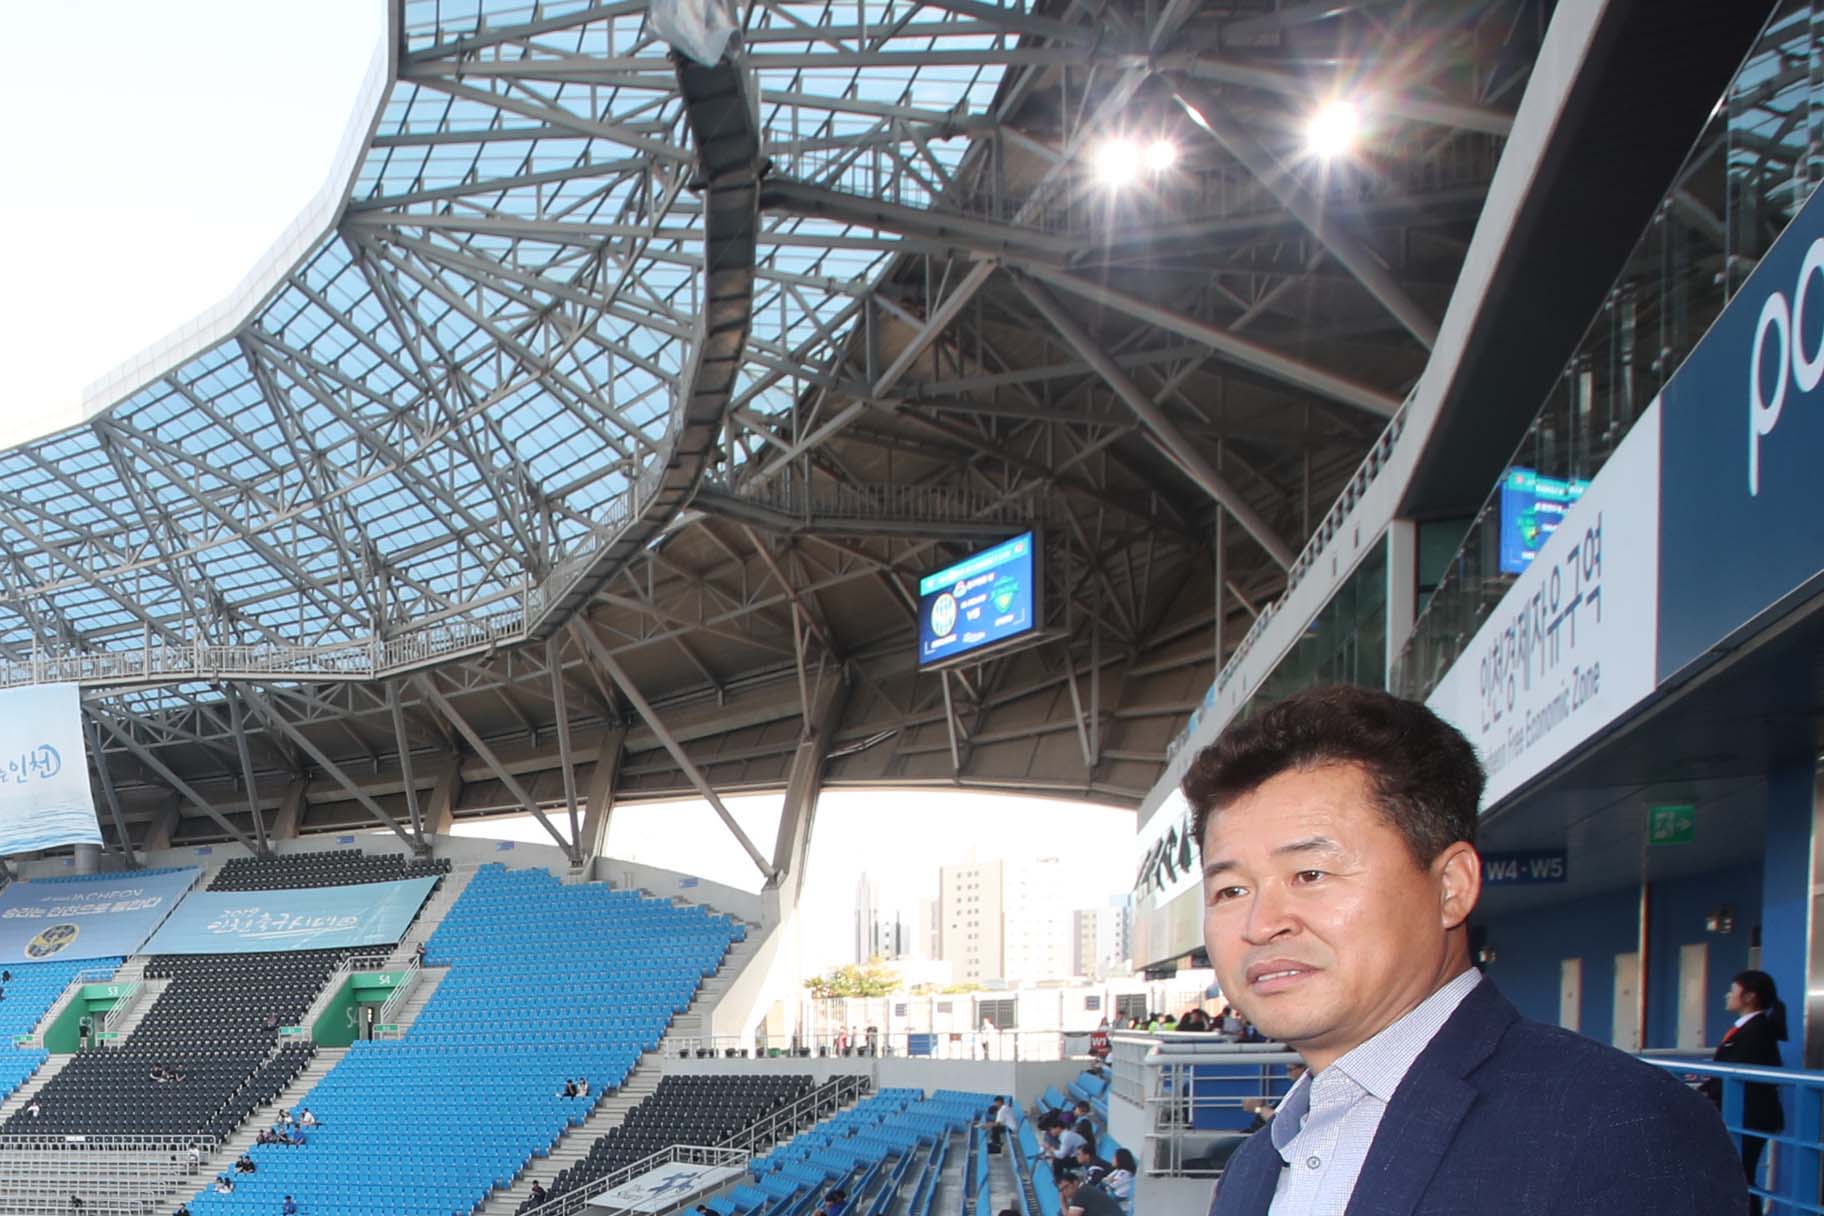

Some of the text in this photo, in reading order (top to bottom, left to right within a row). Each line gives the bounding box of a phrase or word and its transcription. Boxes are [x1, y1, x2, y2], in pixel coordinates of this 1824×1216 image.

[1480, 511, 1603, 734] 인천경제자유구역
[1526, 678, 1570, 749] Economic
[1572, 661, 1601, 712] Zone
[8, 743, 63, 785] 인천
